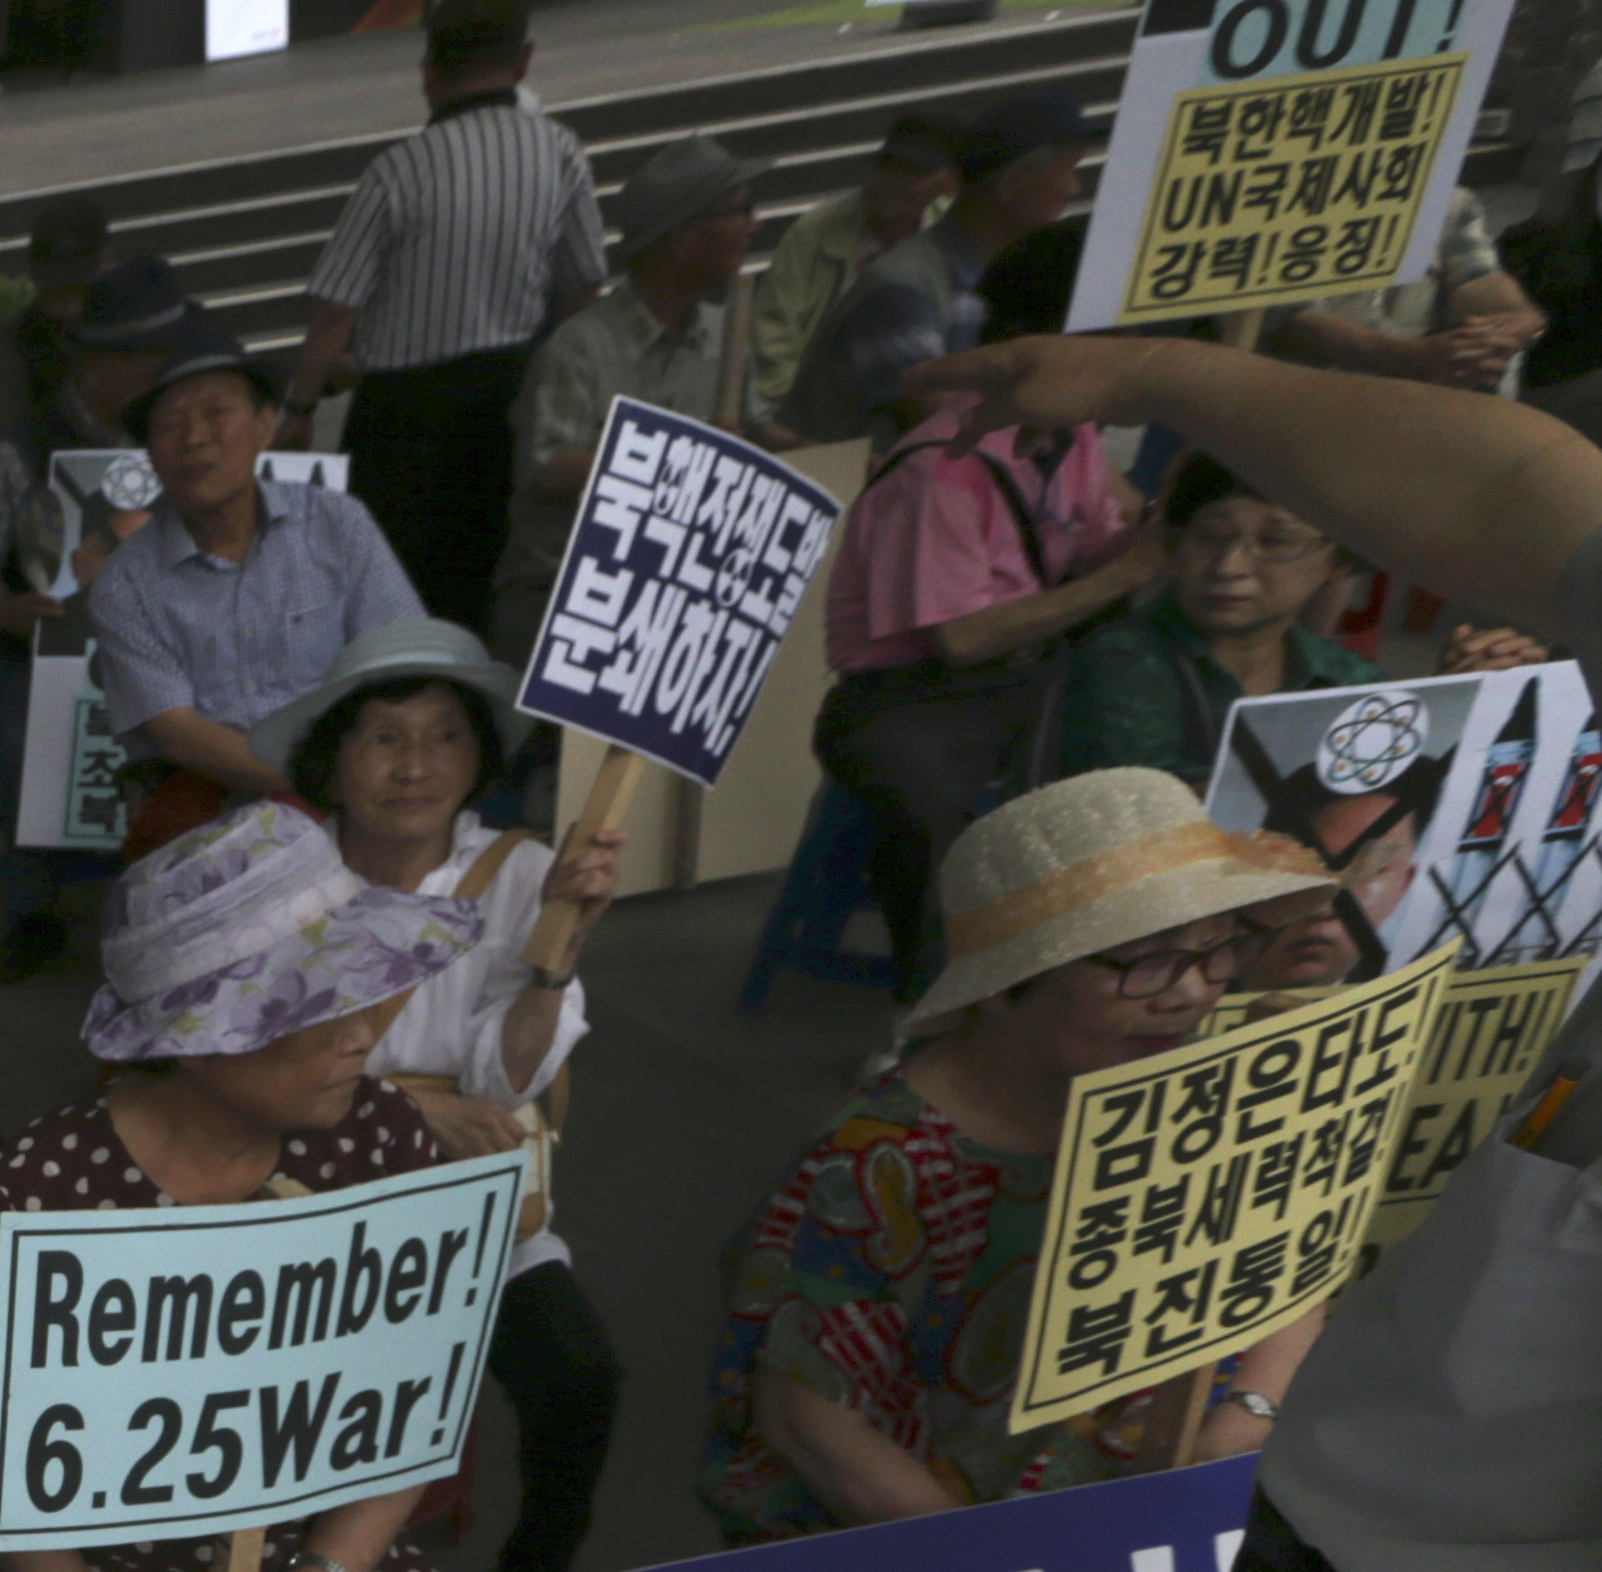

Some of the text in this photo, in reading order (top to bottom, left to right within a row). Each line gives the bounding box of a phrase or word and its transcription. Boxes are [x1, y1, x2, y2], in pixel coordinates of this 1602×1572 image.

[1427, 988, 1555, 1087] ITH!
[29, 1190, 498, 1369] Remember!
[24, 1341, 468, 1514] 6.25War!
